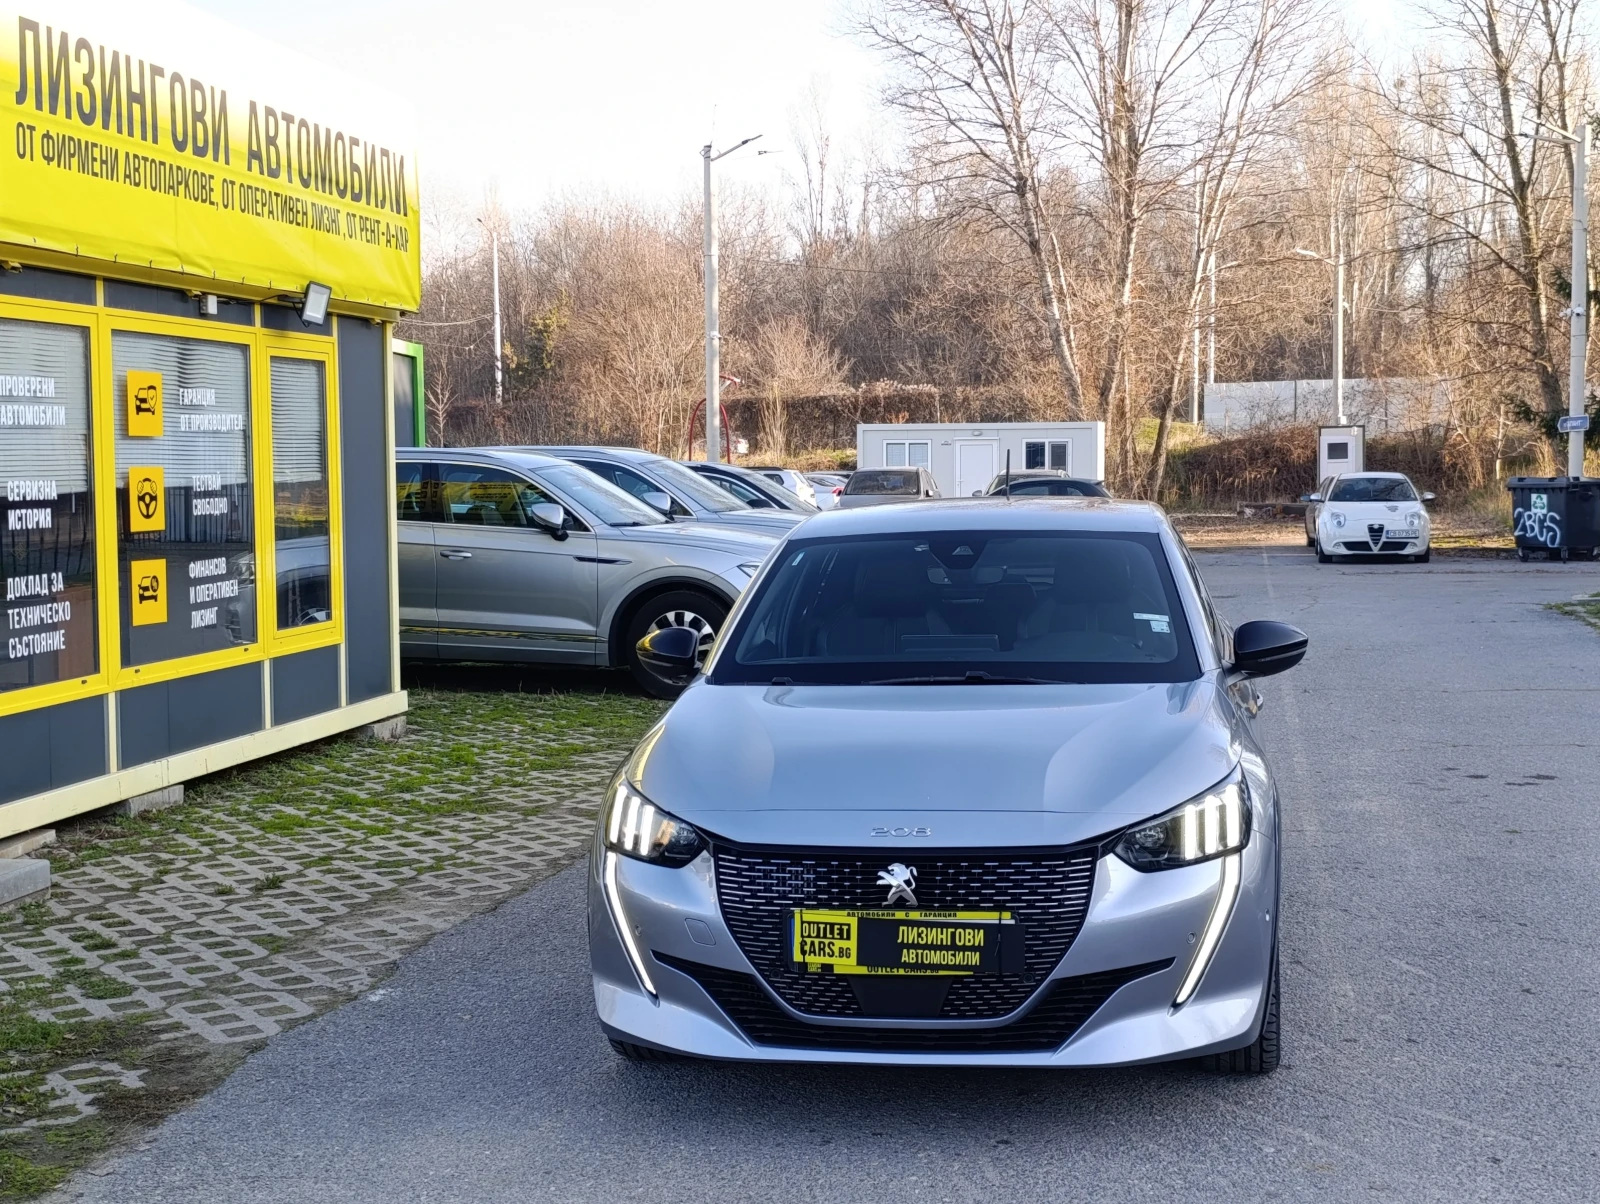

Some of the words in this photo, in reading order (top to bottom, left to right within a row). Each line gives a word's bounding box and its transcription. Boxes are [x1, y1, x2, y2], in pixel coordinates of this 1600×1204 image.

[15, 15, 231, 166] ЛИЗИНГОВИ
[247, 99, 409, 218] АВТОМОБИЛИ
[16, 121, 36, 162] ОТ
[41, 129, 120, 183] ФИРМЕНИ
[123, 150, 219, 211] АВТОПАРКОВЕ,
[221, 177, 236, 210] ОТ
[239, 182, 308, 229] ОПЕРАТИВЕН
[345, 211, 358, 240] ОТ
[359, 216, 409, 253] РЕНТ-А-КАР
[0, 375, 55, 398] ПРОВЕРЕНИ
[179, 388, 216, 407] ГАРАНЦИЯ
[0, 405, 66, 426] АВТОМОБИЛИ
[180, 414, 189, 431] ОТ
[191, 414, 243, 432] ПРОИЗВОДИТЕЛ
[7, 479, 58, 502] СЕРВИЗНА
[192, 471, 221, 492] ТЕСТВАЙ
[192, 497, 228, 516] СВОБОДНО
[8, 508, 52, 531] ИСТОРИЯ
[188, 557, 227, 580] ФИНАНСОВ
[7, 573, 49, 602] ДОКЛАД
[51, 571, 64, 593] ЗА
[189, 586, 195, 604] И
[196, 579, 239, 603] ОПЕРАТИВЕН
[7, 601, 71, 630] ТЕХНИЧЕСКО
[190, 606, 219, 629] ЛИЗИНГ
[8, 629, 66, 659] СЪСТОЯНИЕ
[870, 827, 932, 838] 208
[802, 922, 849, 939] OUTLET
[897, 925, 985, 947] ЛИЗИНГОВИ
[800, 938, 852, 959] CARS.BG
[901, 948, 980, 966] АВТОМОБИЛИ
